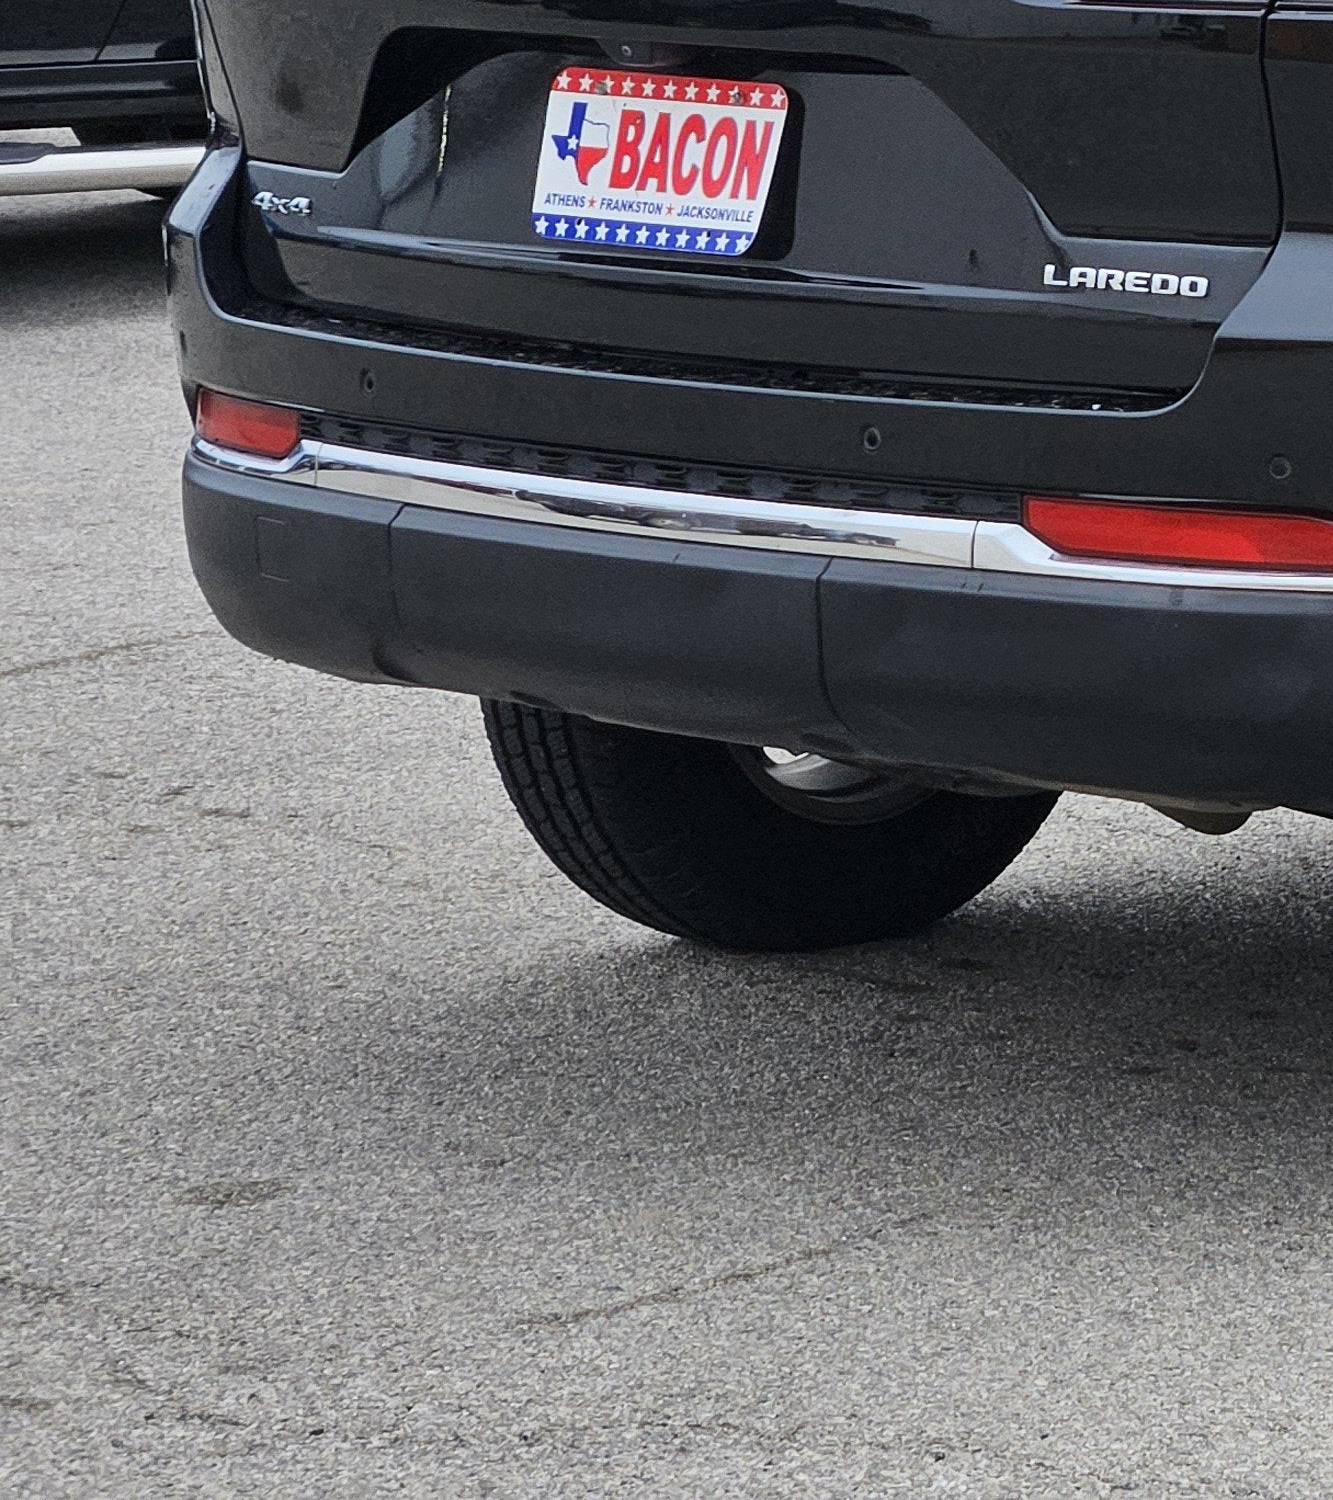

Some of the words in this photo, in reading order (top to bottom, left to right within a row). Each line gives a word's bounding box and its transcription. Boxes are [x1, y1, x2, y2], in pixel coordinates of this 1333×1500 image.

[609, 109, 774, 200] BACON
[544, 192, 586, 208] ATHENS
[600, 197, 663, 216] FRANKSTON
[677, 206, 754, 223] JACKSONVILLE
[1043, 264, 1208, 297] LAREDO
